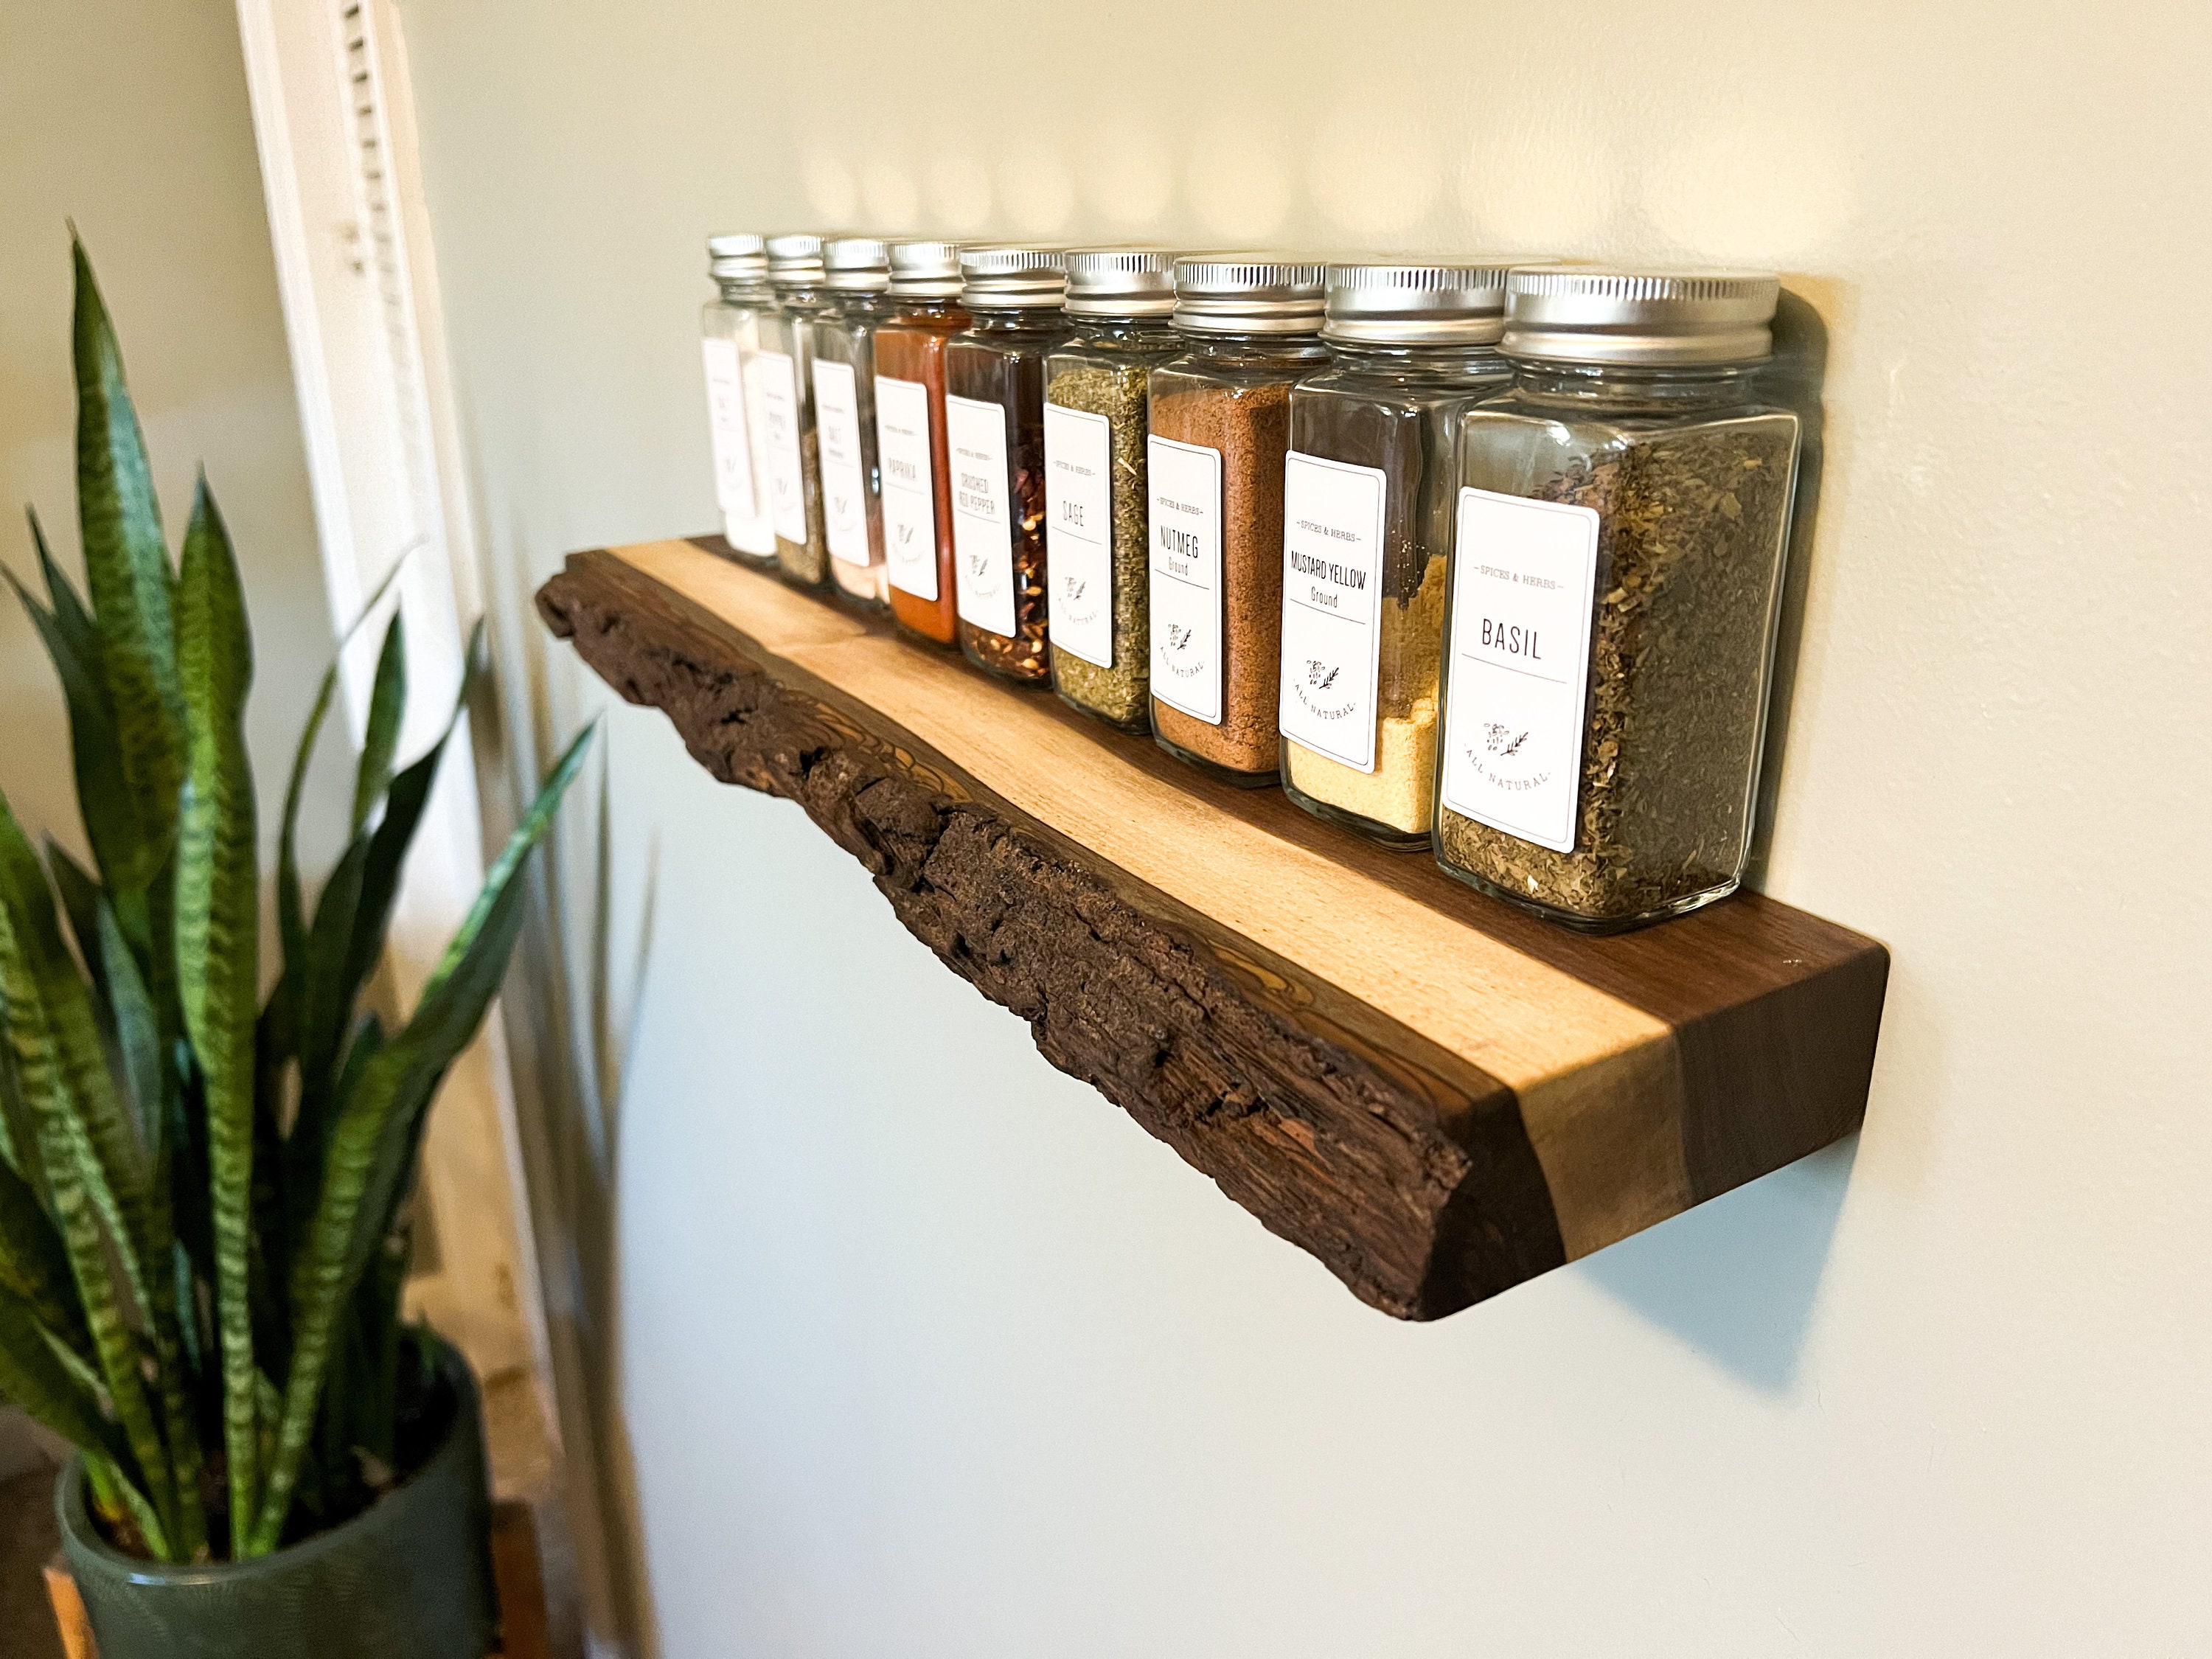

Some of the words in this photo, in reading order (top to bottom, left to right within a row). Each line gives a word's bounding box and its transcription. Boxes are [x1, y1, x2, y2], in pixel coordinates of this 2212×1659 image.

[1062, 500, 1085, 526] SAGE
[1161, 524, 1198, 559] NUTMEG
[1324, 526, 1329, 535] &
[1169, 556, 1188, 576] Ground
[1291, 550, 1326, 580] MUSTARD
[1329, 563, 1366, 591] YELLOW
[1512, 572, 1519, 582] &
[1311, 586, 1338, 608] Ground
[1481, 618, 1542, 660] BASIL
